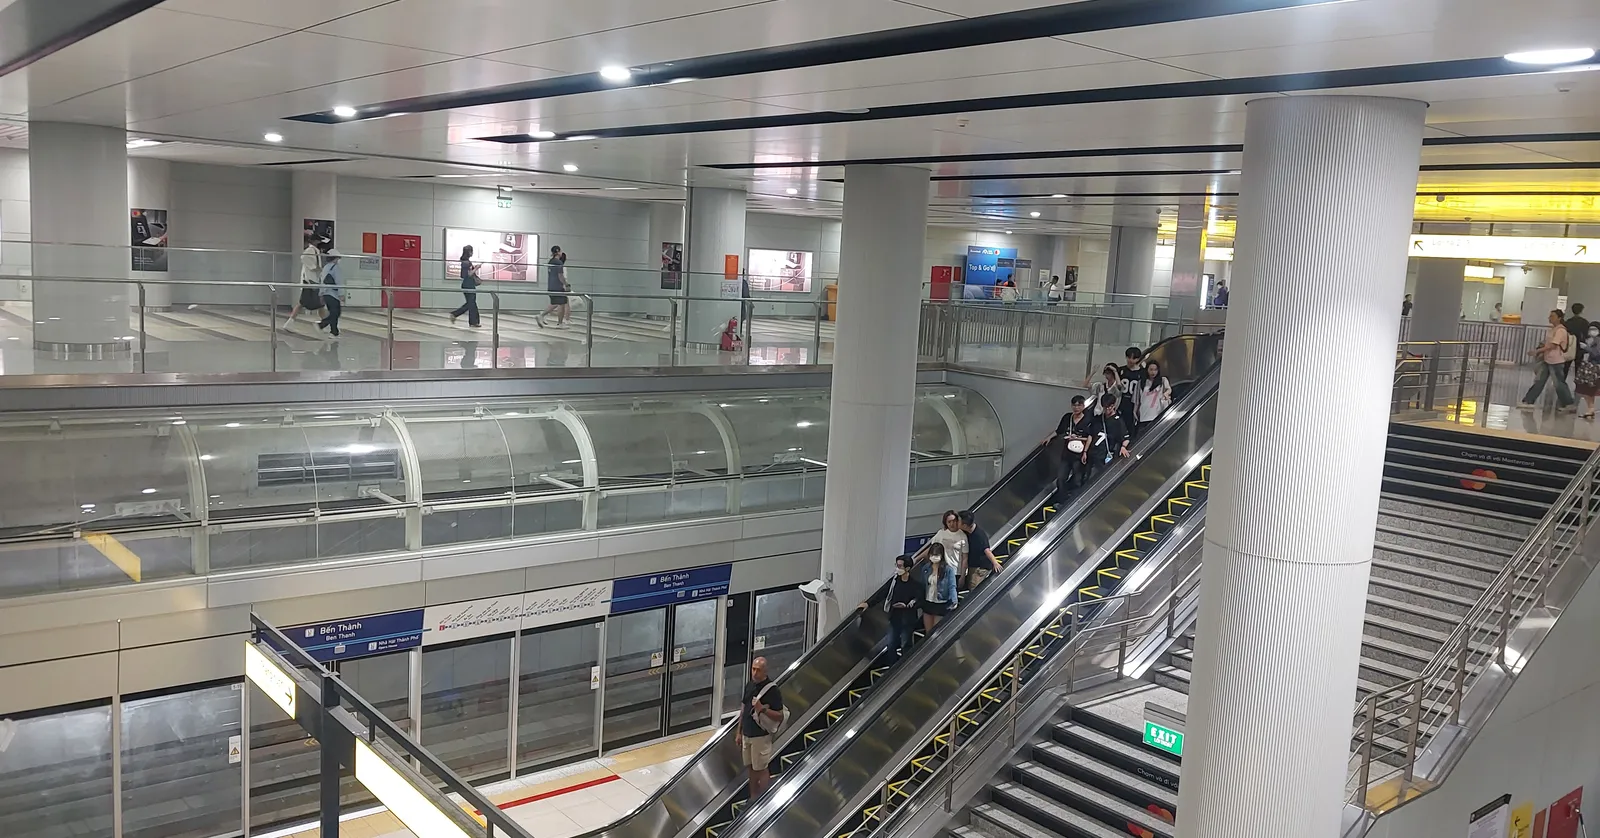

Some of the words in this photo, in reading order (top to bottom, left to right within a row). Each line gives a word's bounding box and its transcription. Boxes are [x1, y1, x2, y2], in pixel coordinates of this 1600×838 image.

[1502, 457, 1535, 466] Mastercard
[320, 624, 336, 635] Bến
[338, 622, 362, 632] Thành
[1150, 726, 1177, 744] EXIT
